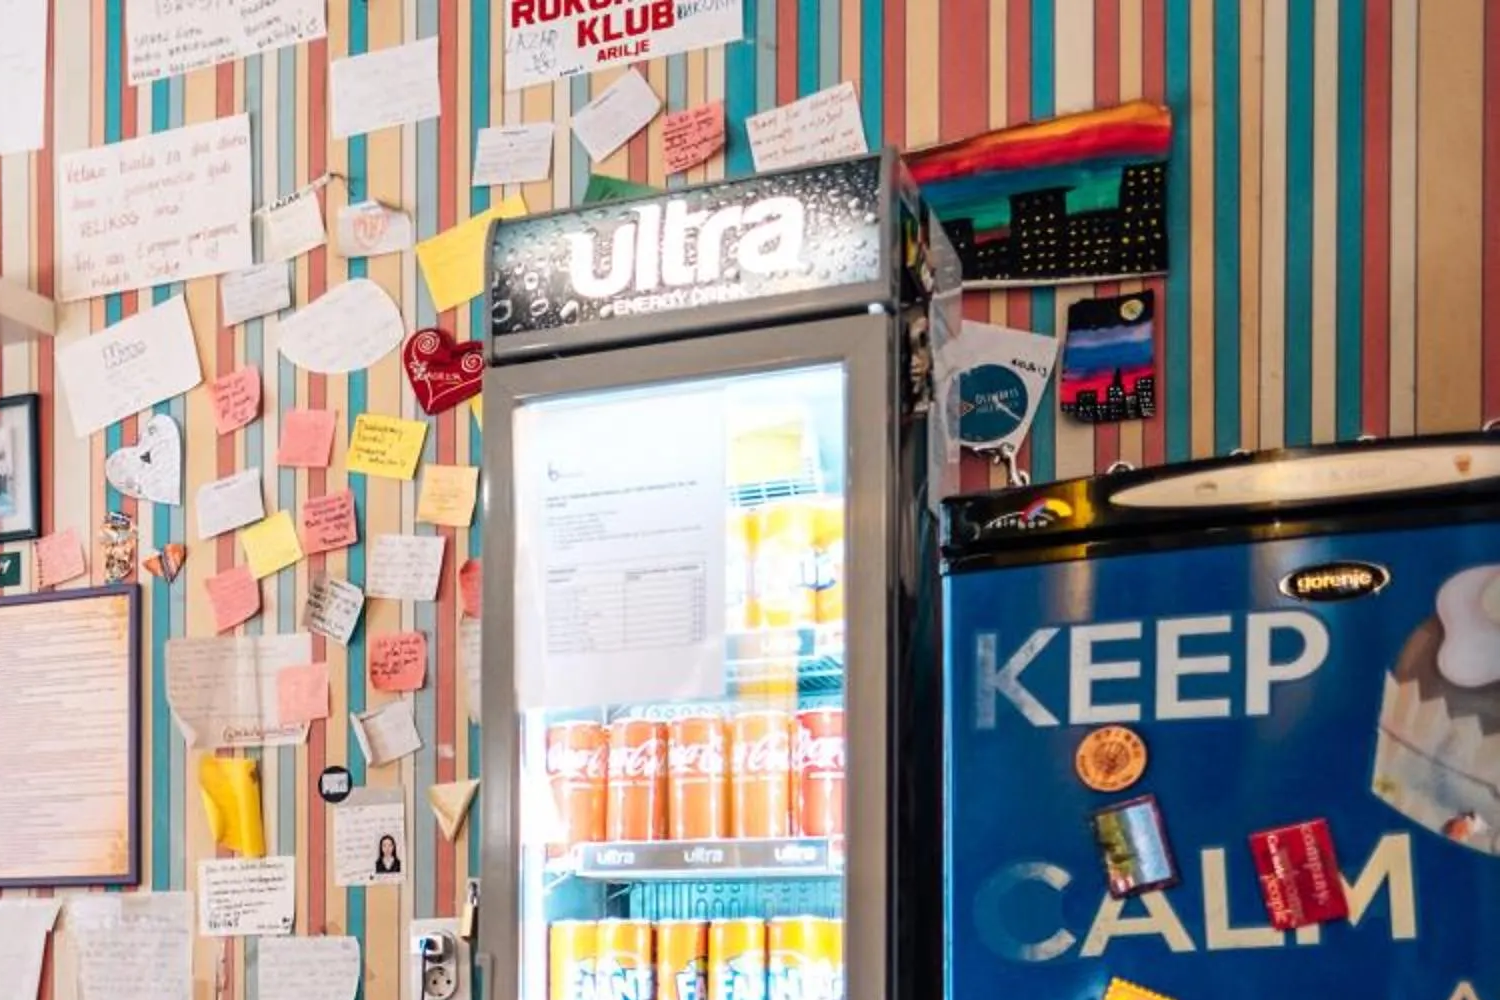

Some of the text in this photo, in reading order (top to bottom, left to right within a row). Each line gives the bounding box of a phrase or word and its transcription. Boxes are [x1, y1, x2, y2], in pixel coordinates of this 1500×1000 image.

[577, 1, 675, 48] KLUB
[597, 39, 650, 62] ARILJE
[562, 196, 805, 297] ultra
[613, 290, 688, 316] ENERGY
[1296, 572, 1372, 594] gorenje
[975, 610, 1330, 729] KEEP
[683, 846, 723, 864] ultra
[774, 843, 817, 862] ultra
[973, 832, 1418, 964] CALM
